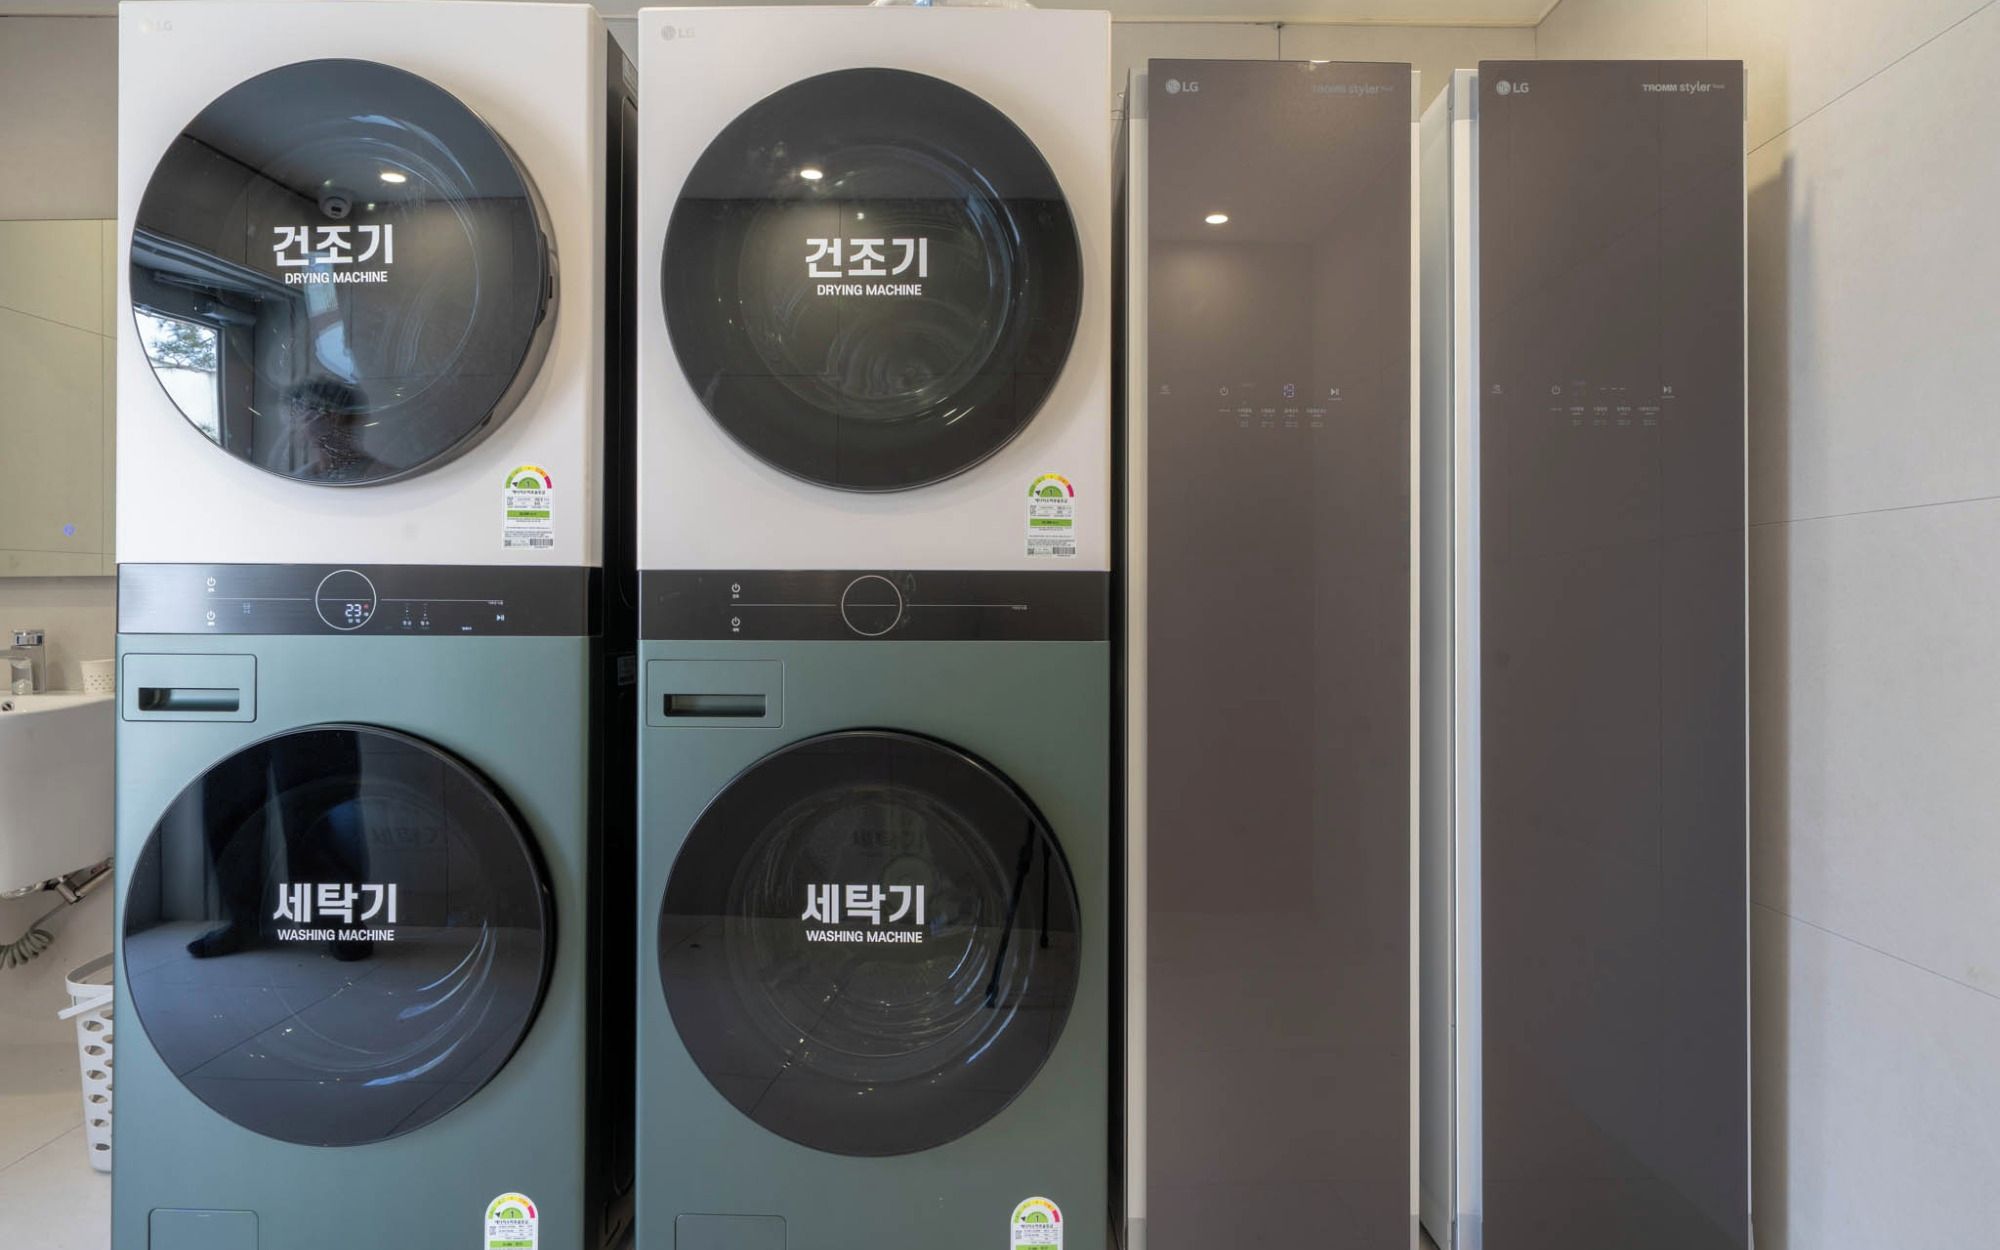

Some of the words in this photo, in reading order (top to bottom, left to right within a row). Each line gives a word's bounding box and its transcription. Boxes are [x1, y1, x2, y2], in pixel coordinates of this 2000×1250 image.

[1182, 82, 1199, 93] LG
[1513, 82, 1529, 93] LG
[1641, 83, 1677, 92] TROMM
[1679, 80, 1712, 94] styler
[273, 224, 393, 266] 건조기
[805, 238, 928, 278] 건조기
[285, 272, 329, 284] DRYING
[332, 271, 388, 284] MACHINE
[817, 284, 862, 296] DRYING
[865, 284, 922, 296] MACHINE
[344, 603, 362, 617] 23
[273, 883, 397, 924] 세탁기
[801, 884, 925, 925] 세탁기
[277, 929, 335, 941] WASHING
[338, 929, 395, 941] MACHINE
[805, 930, 863, 942] WASHING
[866, 931, 923, 943] MACHINE
